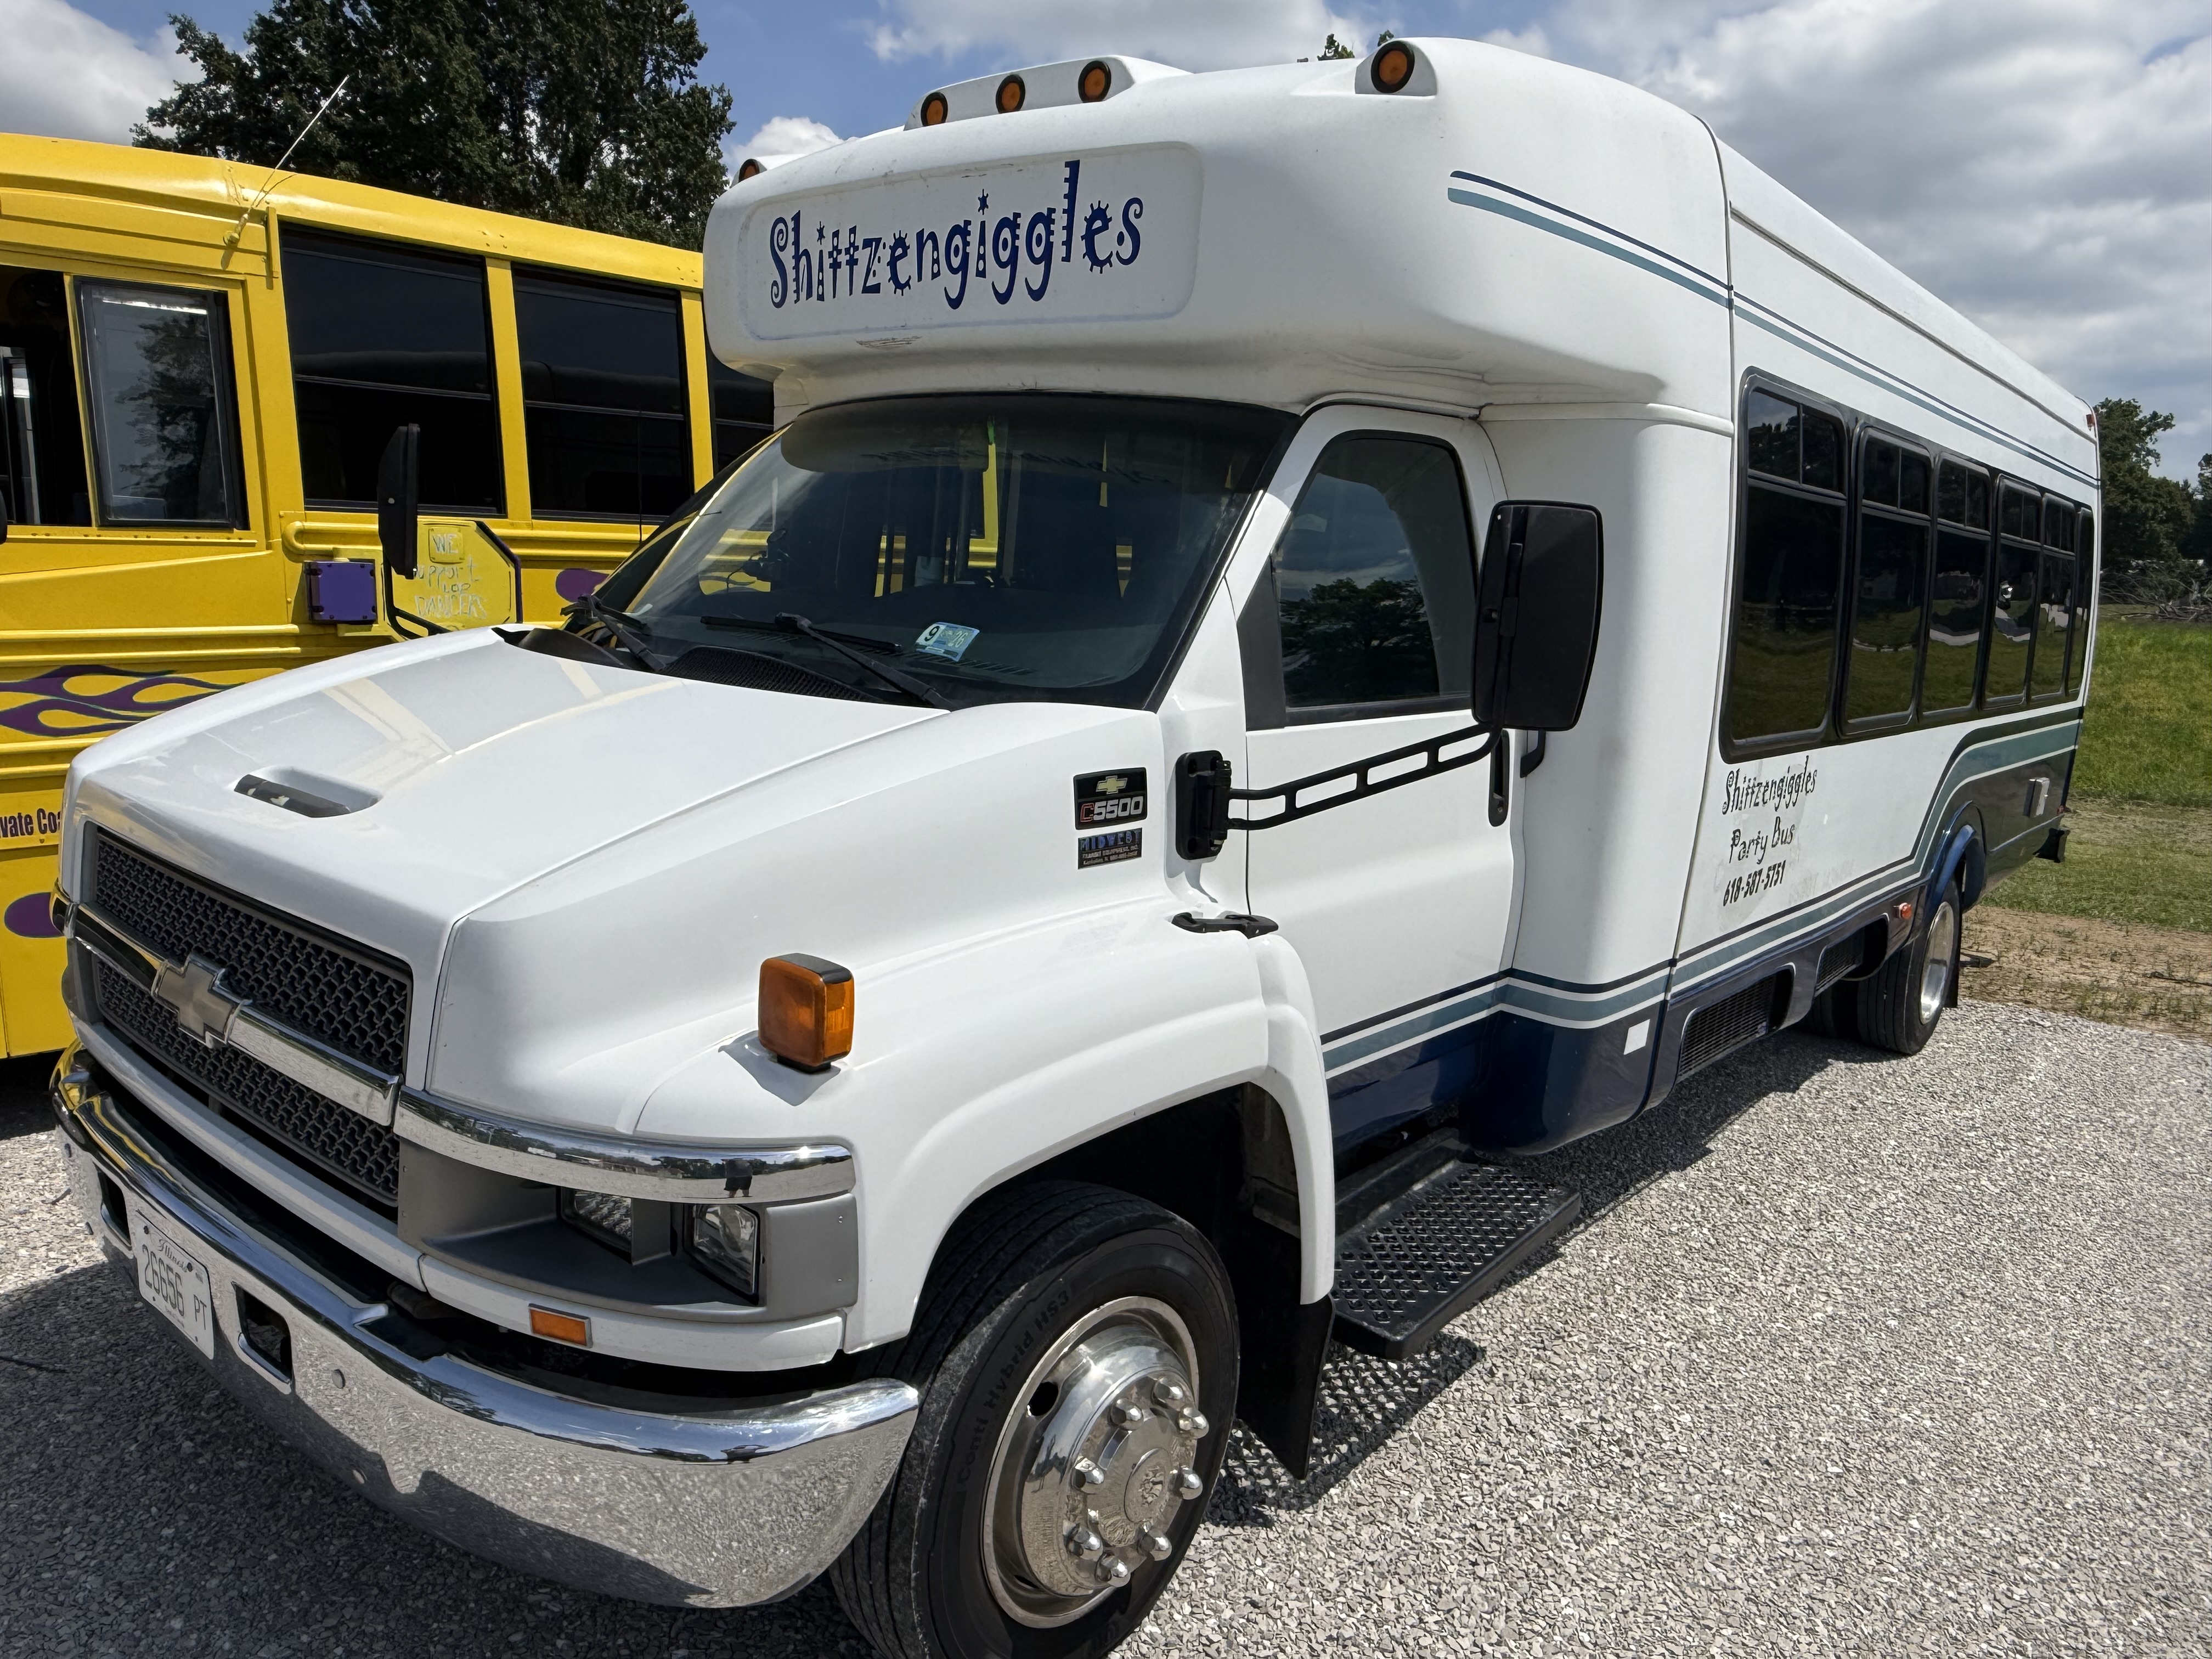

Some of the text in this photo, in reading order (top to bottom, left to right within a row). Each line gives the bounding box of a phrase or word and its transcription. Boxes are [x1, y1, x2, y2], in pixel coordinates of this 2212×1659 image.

[770, 160, 1143, 309] Shittzengiggles
[432, 533, 459, 554] WE
[414, 555, 481, 588] upport
[924, 625, 940, 642] 9
[1722, 755, 1818, 815] Shittzengiggles
[0, 812, 33, 838] vate
[1080, 795, 1144, 823] C5500
[1729, 828, 1768, 865] Party
[1723, 859, 1787, 907] 618-587-5751
[142, 1243, 185, 1317] 26656
[193, 1294, 207, 1330] PT
[984, 1330, 1035, 1410] Hybrid
